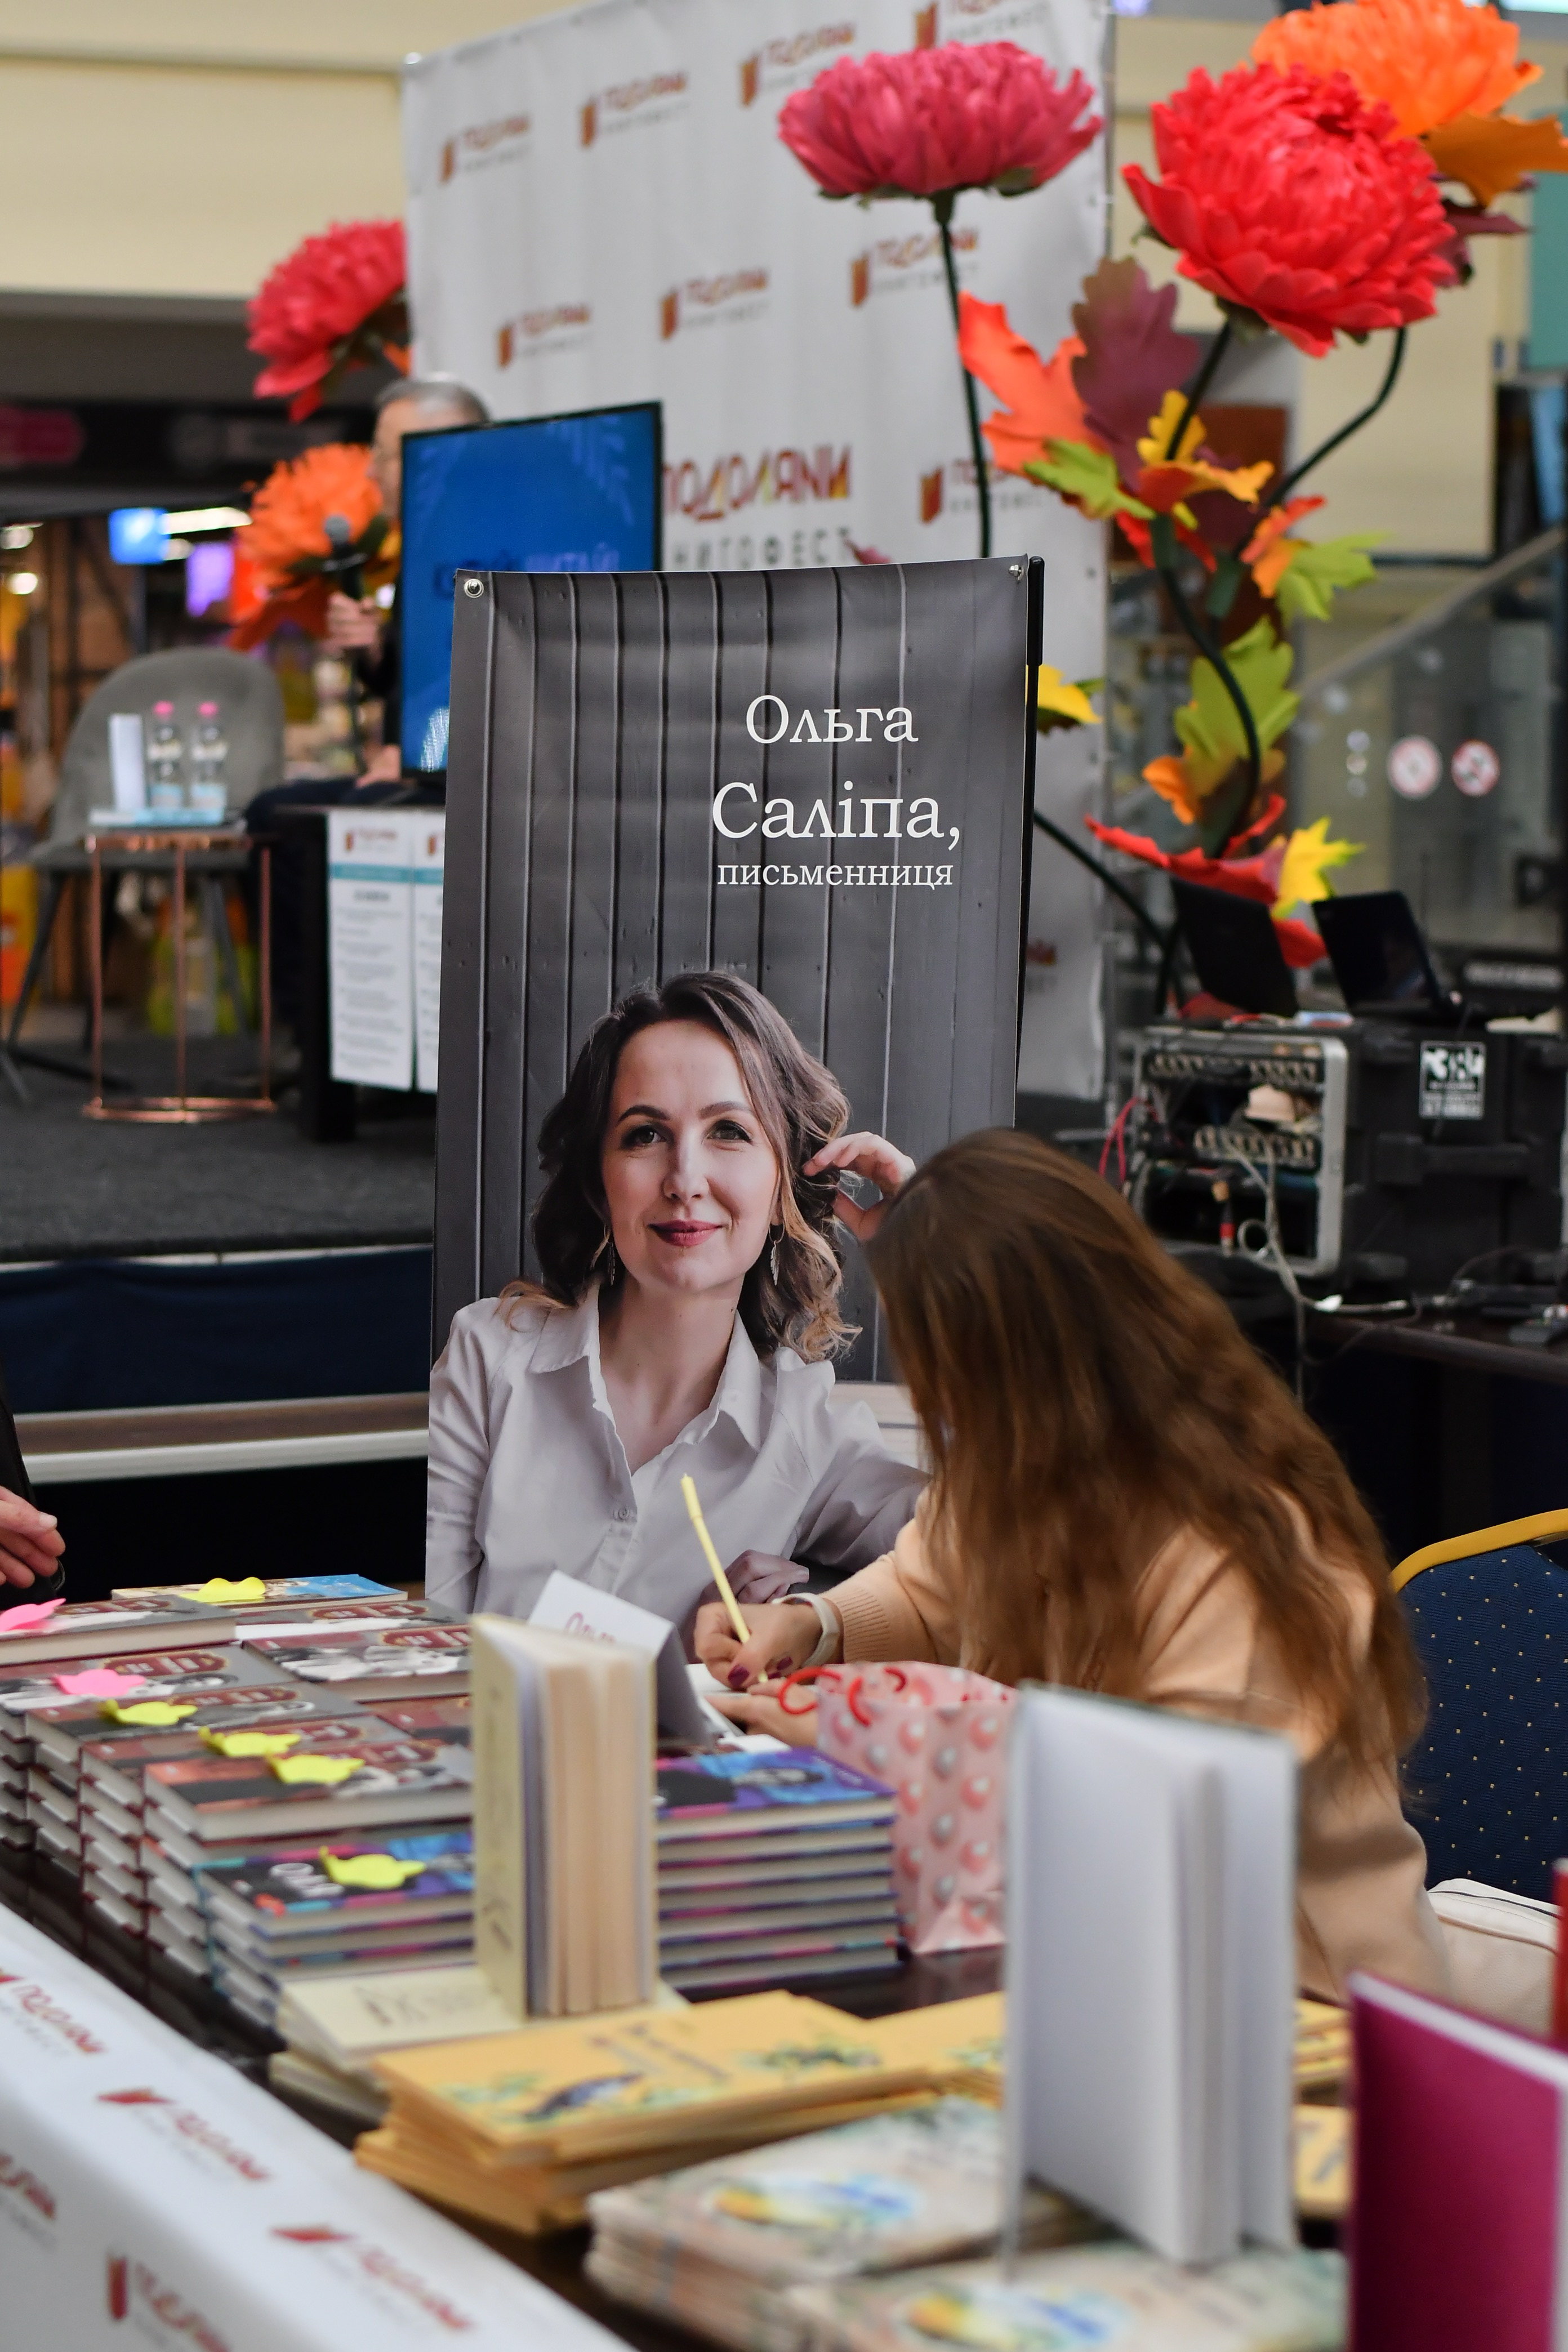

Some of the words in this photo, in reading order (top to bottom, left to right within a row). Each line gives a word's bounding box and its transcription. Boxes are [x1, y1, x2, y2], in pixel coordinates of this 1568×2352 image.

[746, 694, 919, 744] Ольга
[712, 781, 960, 851] Саліпа,
[718, 863, 954, 890] письменниця
